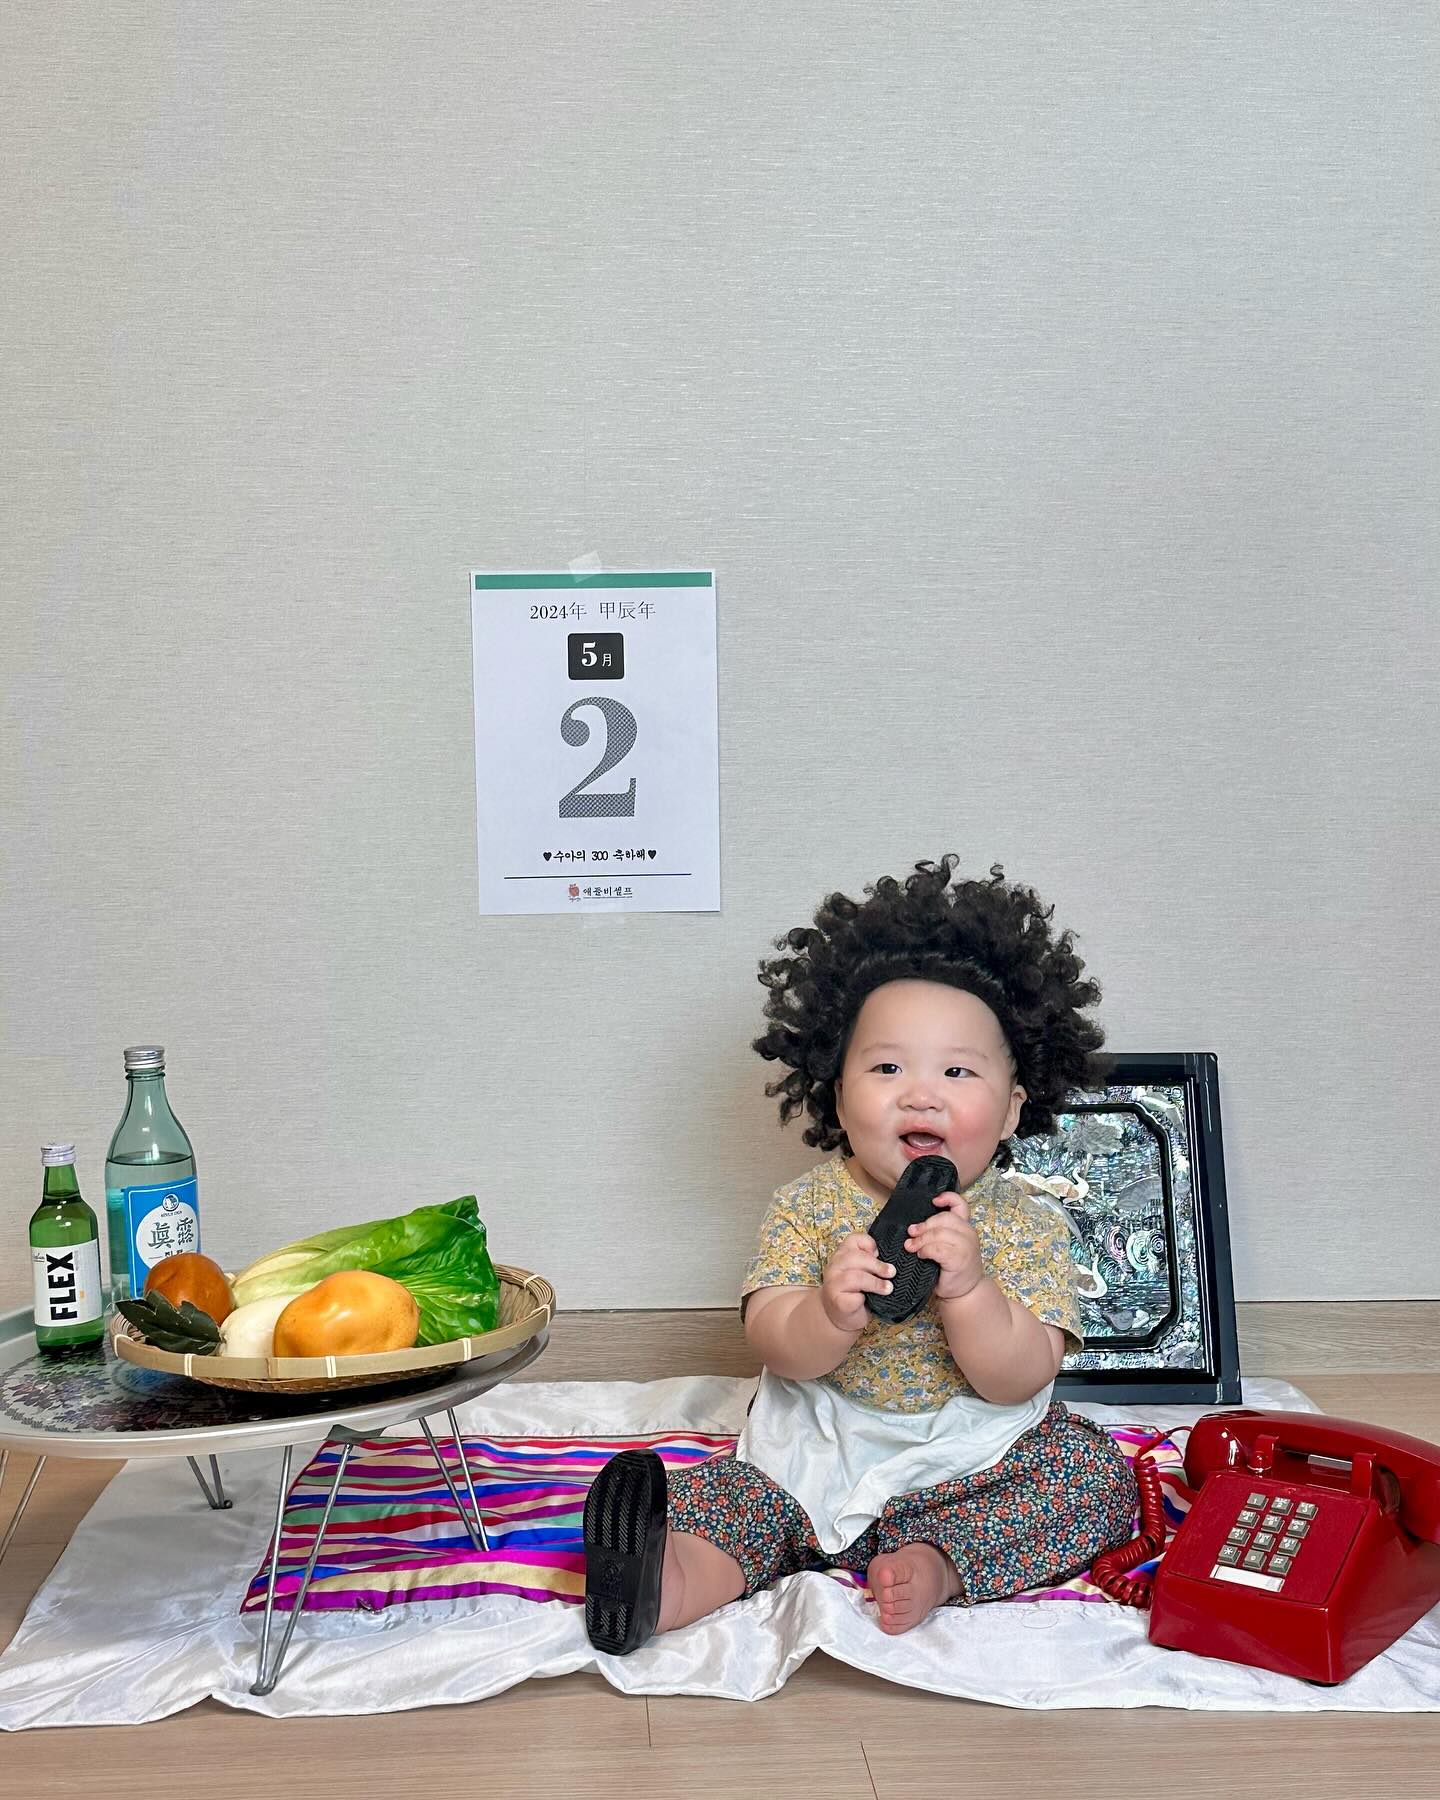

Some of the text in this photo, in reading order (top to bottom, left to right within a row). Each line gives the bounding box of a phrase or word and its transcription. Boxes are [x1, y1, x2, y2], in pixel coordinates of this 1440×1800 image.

[530, 601, 656, 620] 2024年 甲辰年
[581, 641, 612, 667] 5月
[559, 696, 638, 819] 2
[553, 848, 646, 863] 수아의 300 축하해
[46, 1251, 78, 1321] FLEX
